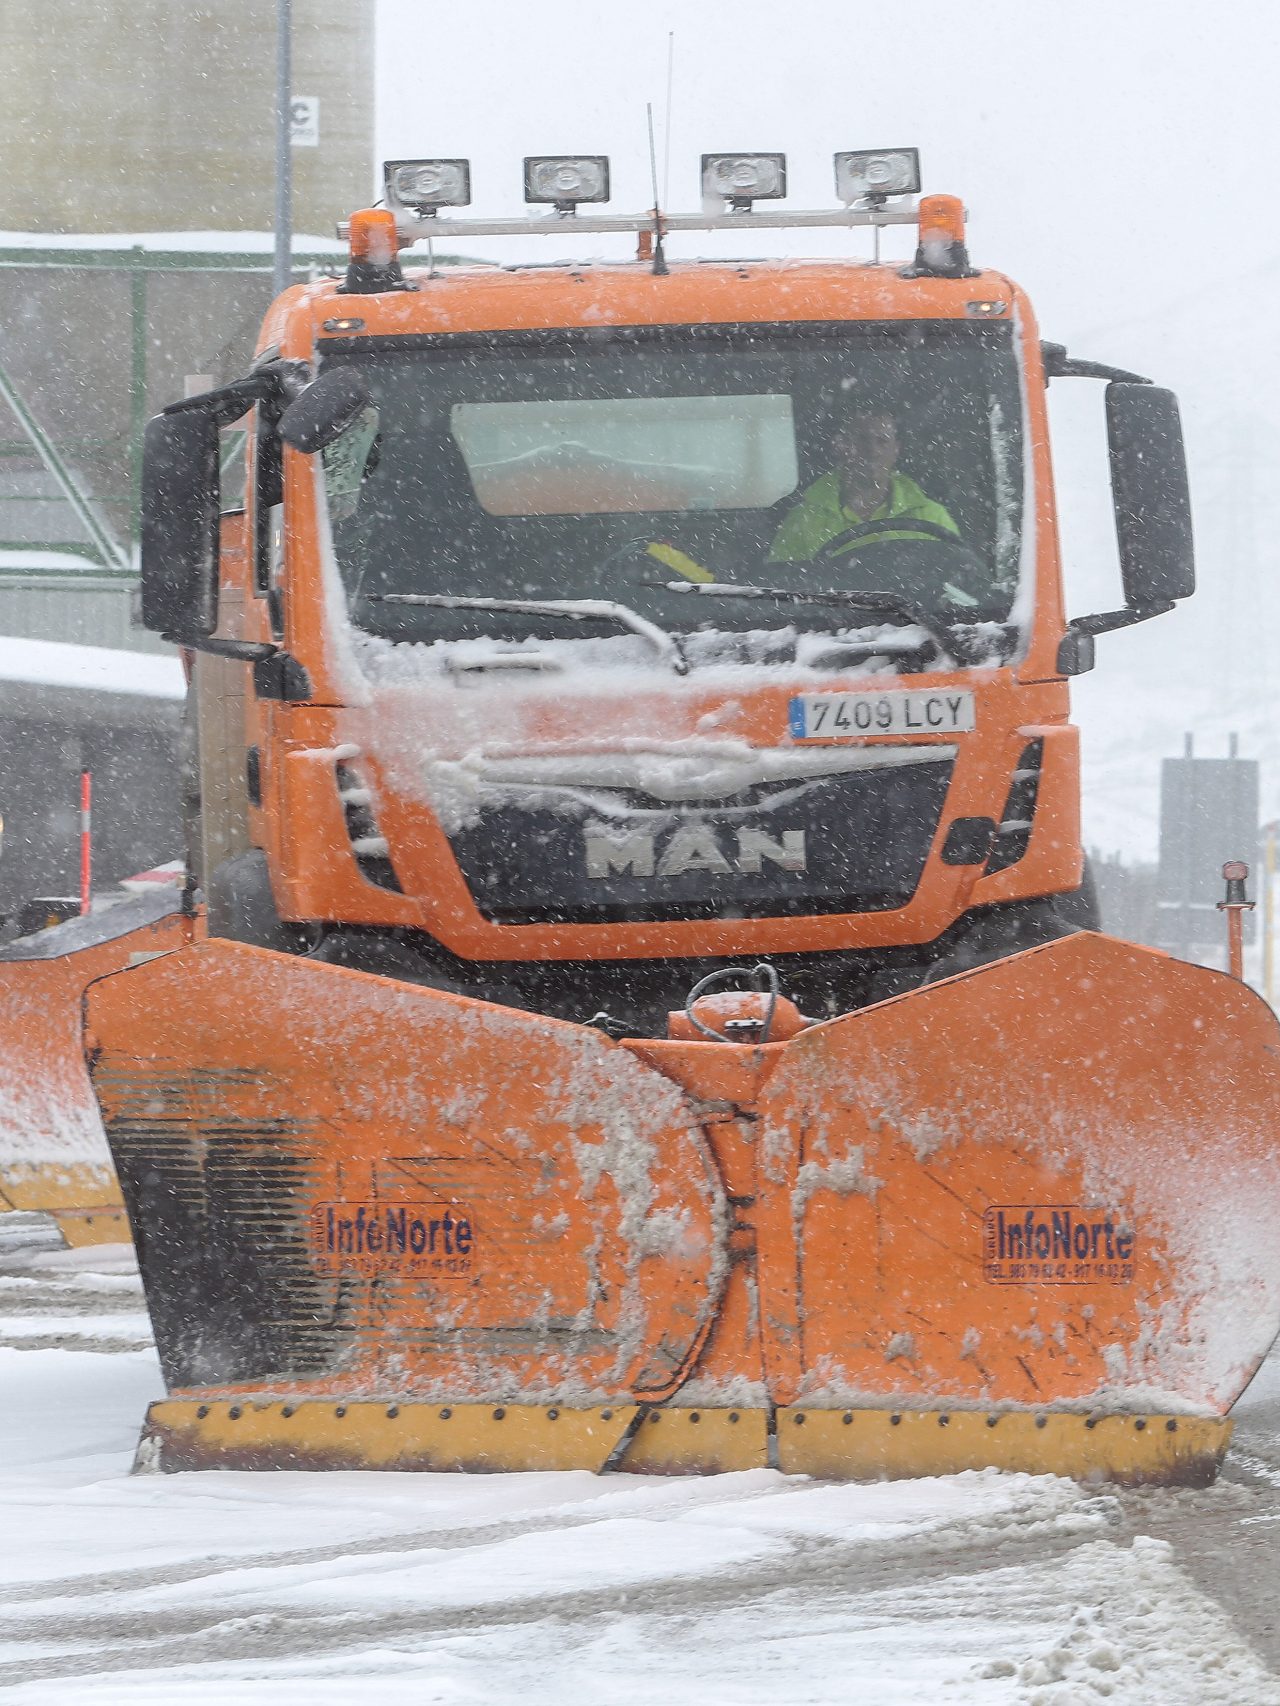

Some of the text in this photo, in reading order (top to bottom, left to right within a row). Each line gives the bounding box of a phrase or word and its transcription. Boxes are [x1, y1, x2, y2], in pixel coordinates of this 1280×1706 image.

[813, 697, 963, 731] 7409 LCY
[584, 827, 806, 878] MAN
[998, 1211, 1133, 1259] InfoNorte
